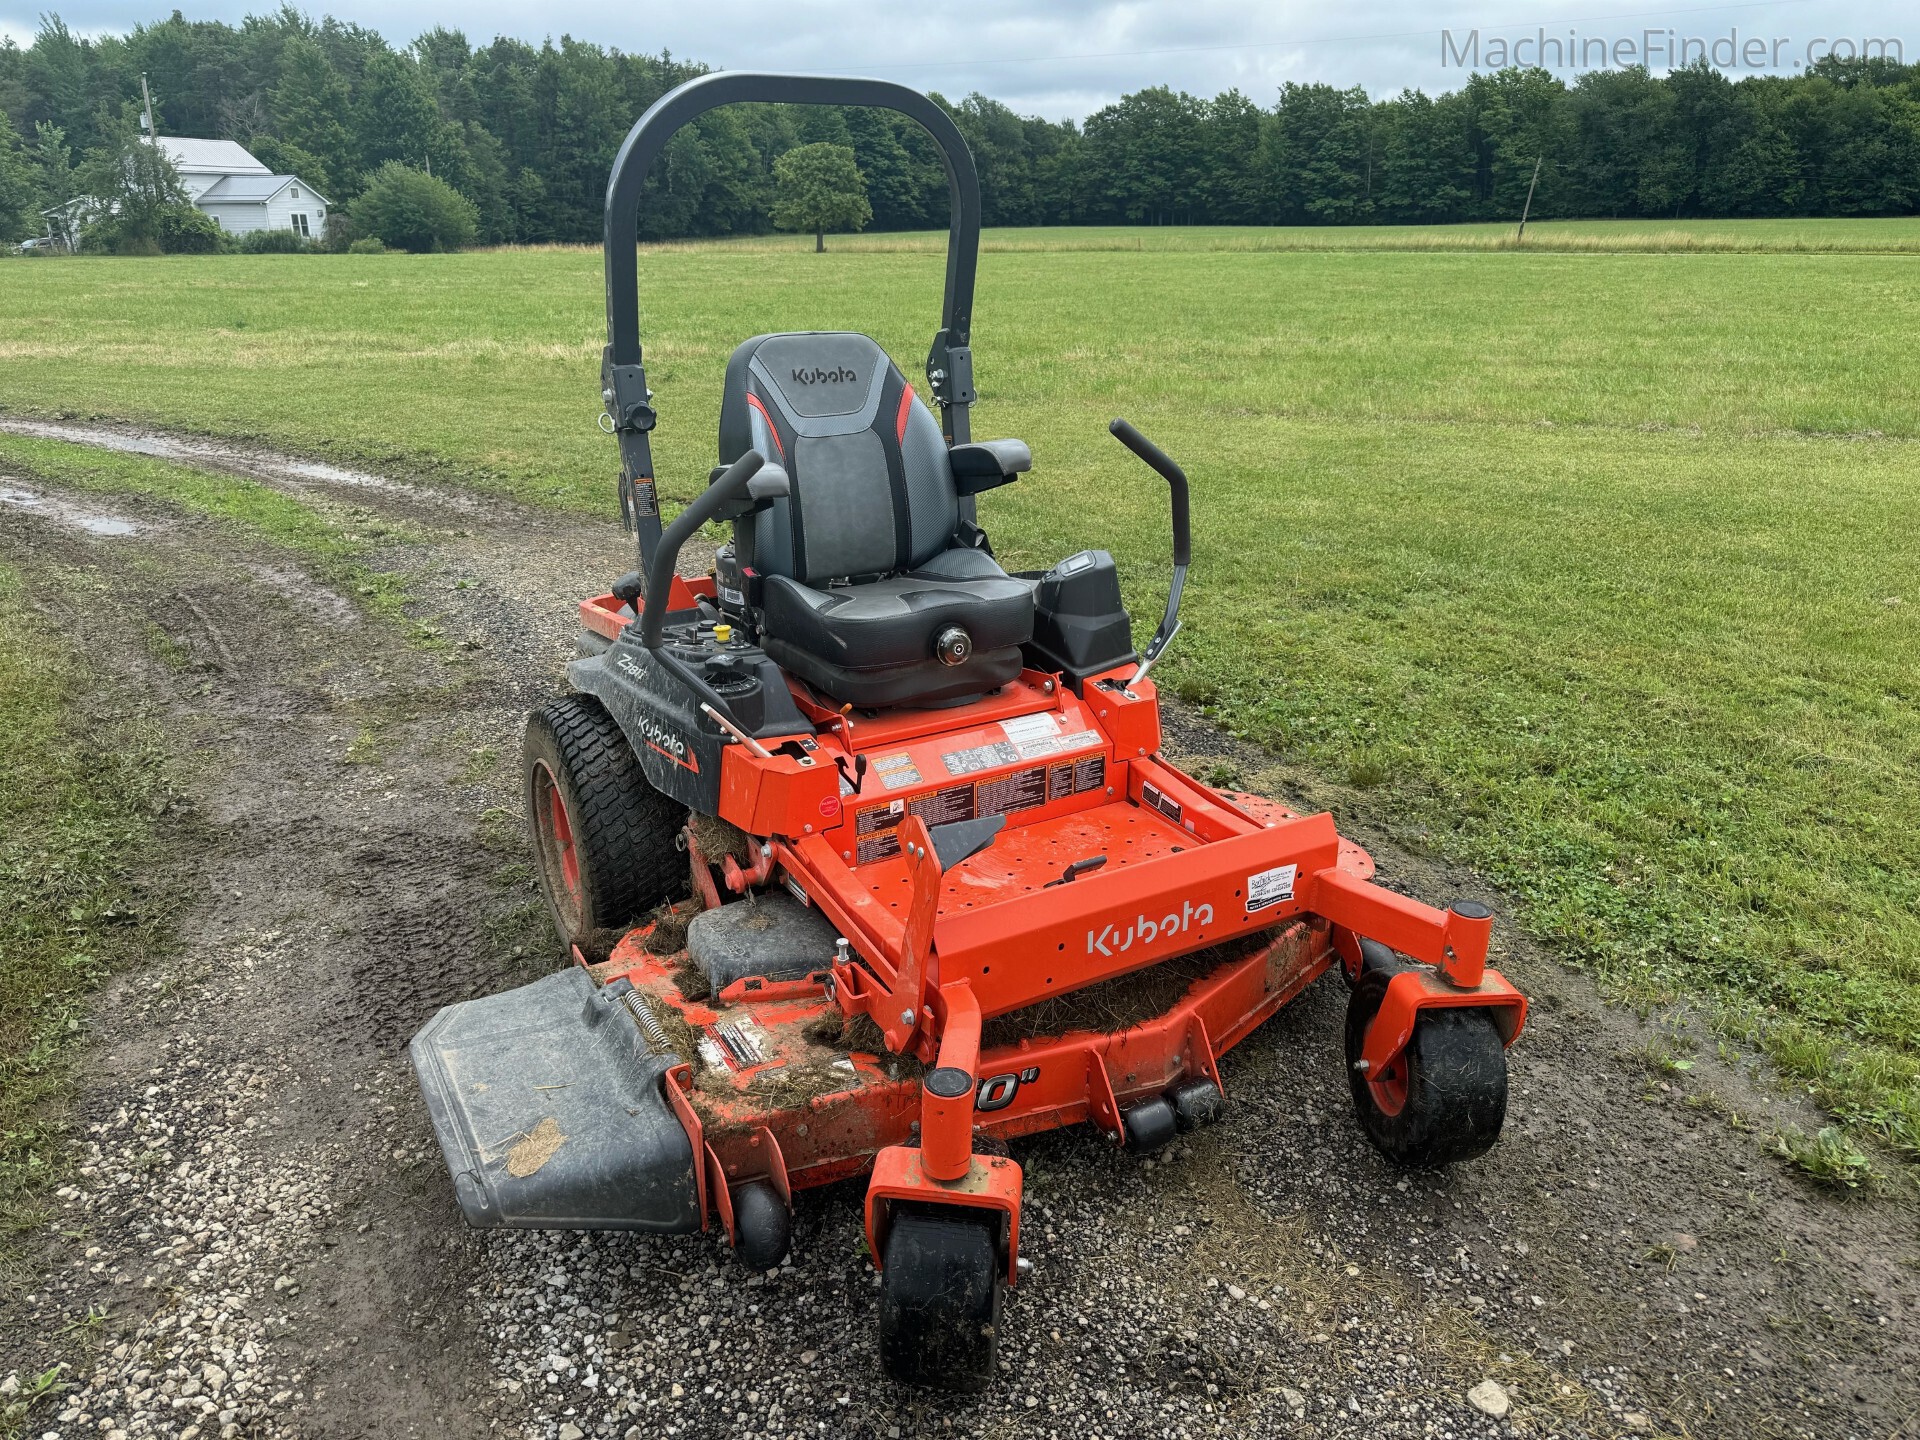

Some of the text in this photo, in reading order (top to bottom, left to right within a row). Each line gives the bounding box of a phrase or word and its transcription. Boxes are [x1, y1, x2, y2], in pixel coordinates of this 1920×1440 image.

[791, 366, 857, 385] Kubota
[638, 715, 684, 755] Kubota
[1087, 900, 1214, 957] Kubota
[974, 1067, 1040, 1113] 0"
